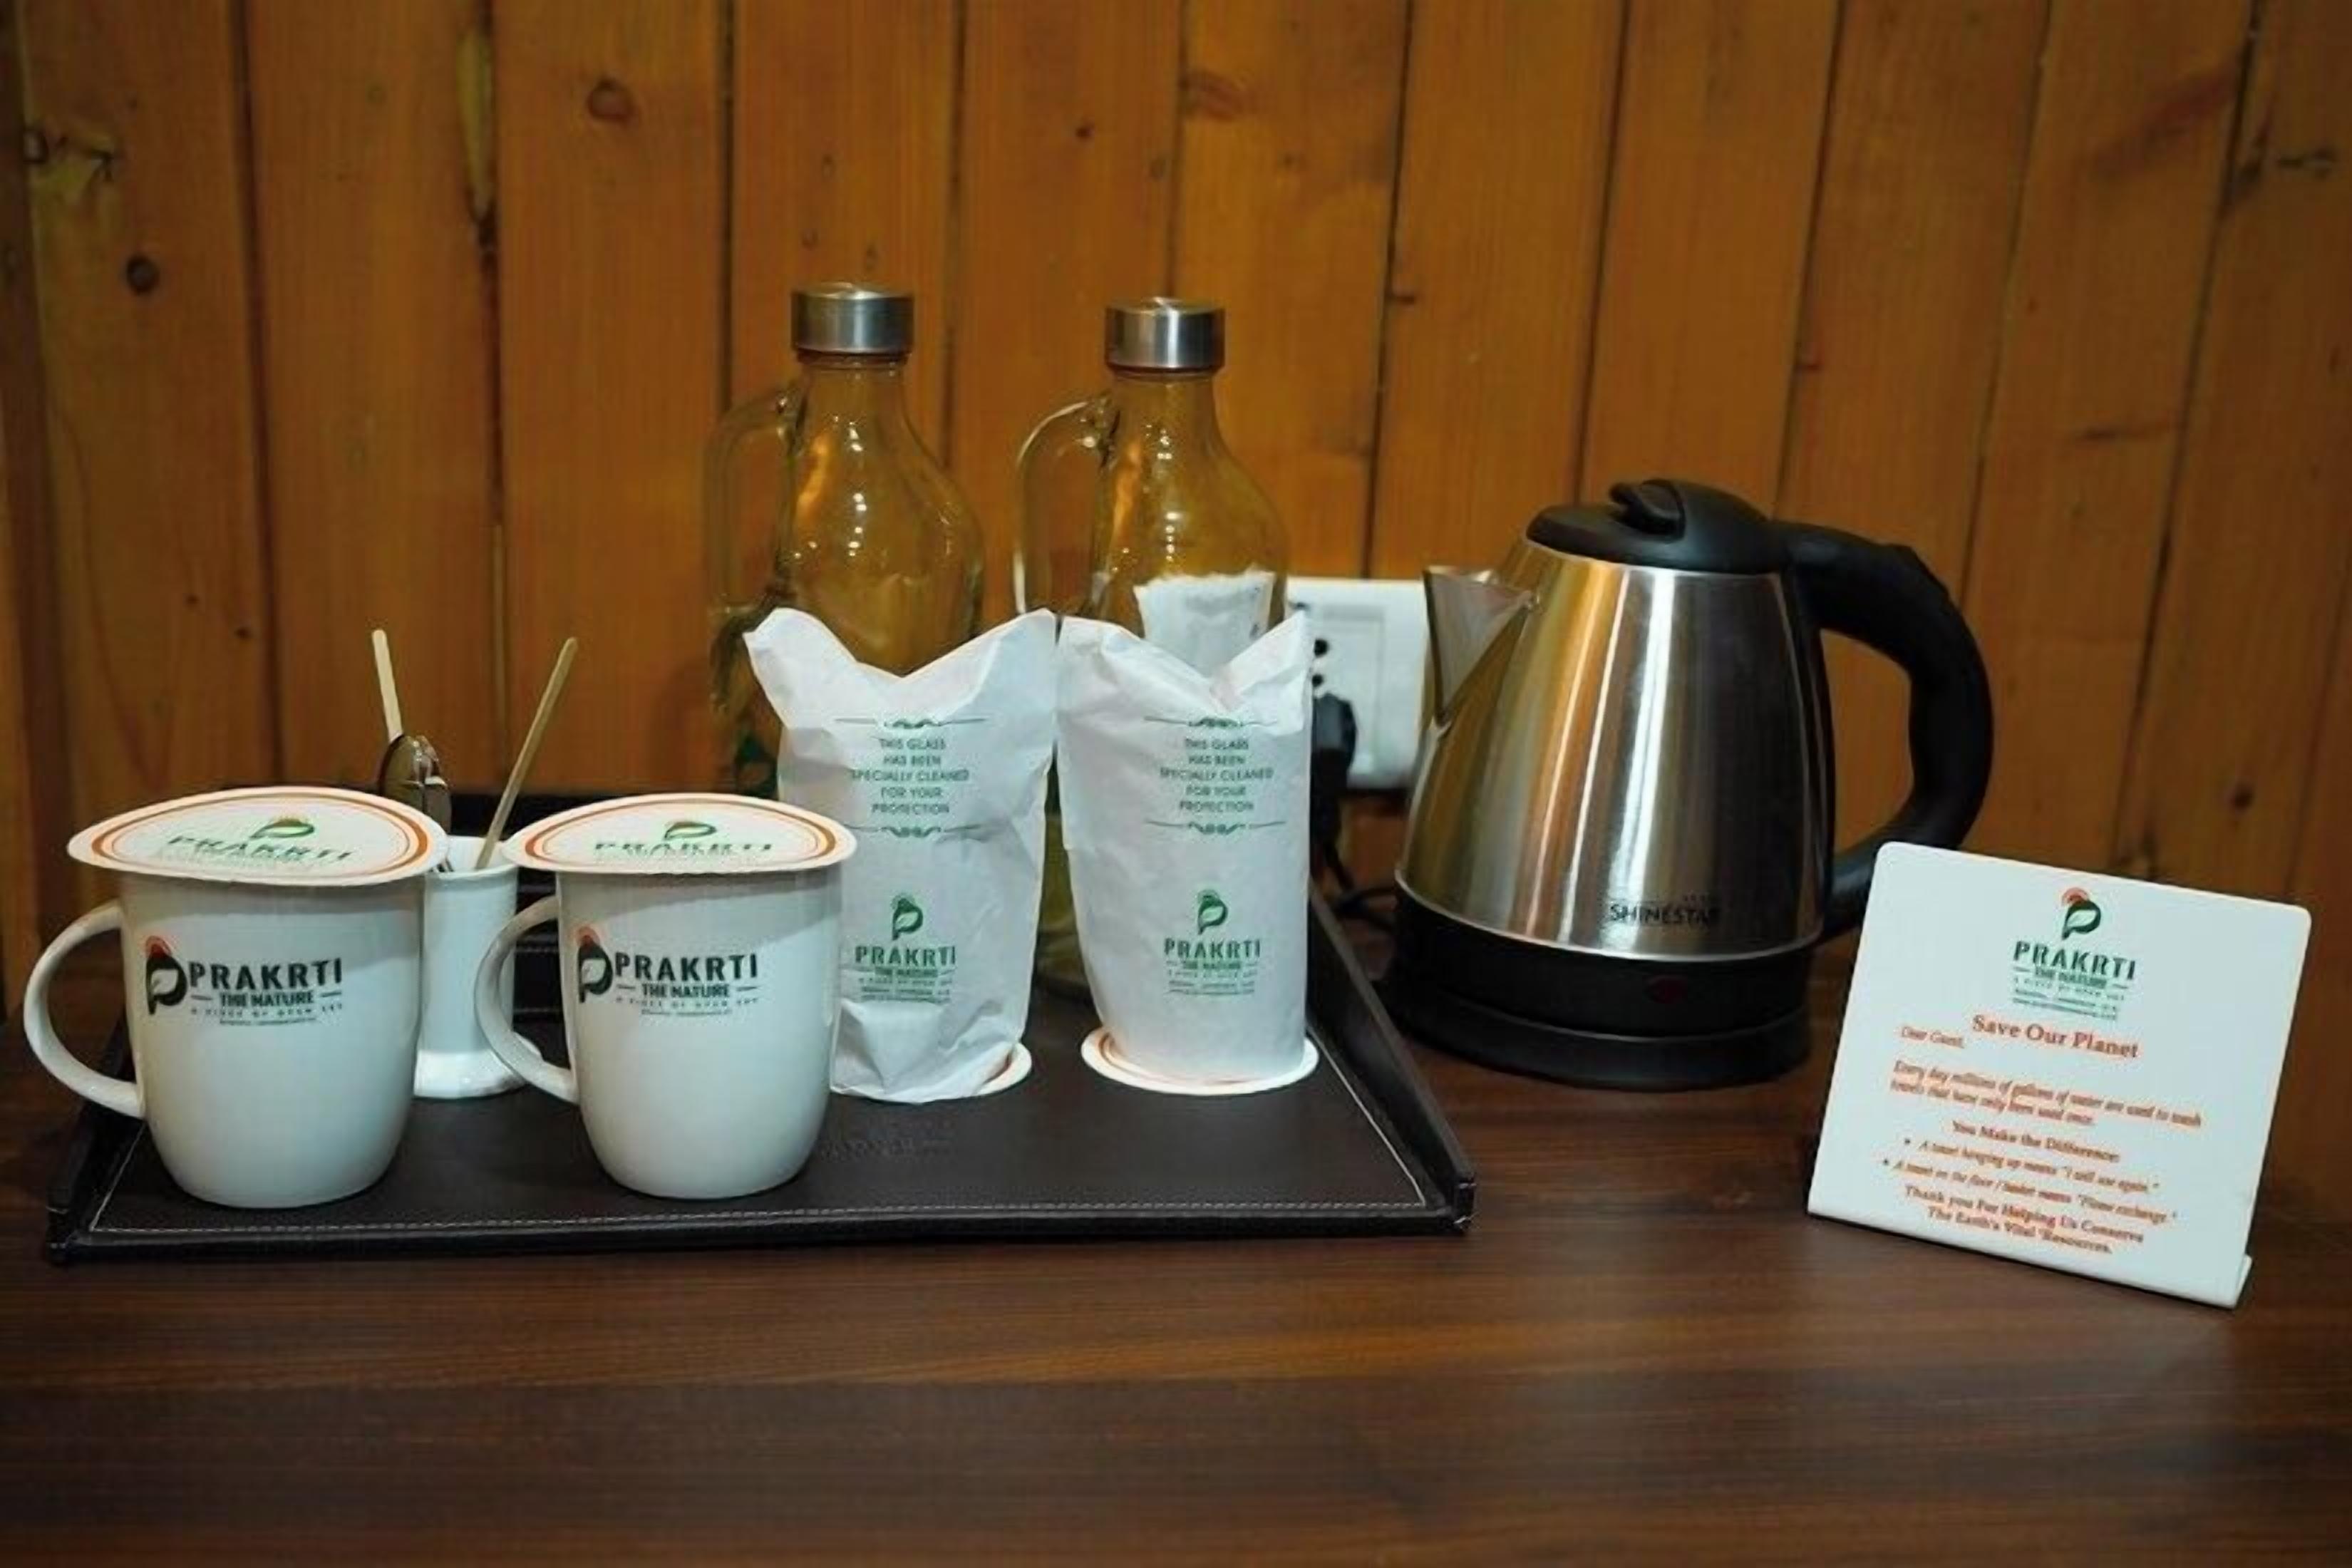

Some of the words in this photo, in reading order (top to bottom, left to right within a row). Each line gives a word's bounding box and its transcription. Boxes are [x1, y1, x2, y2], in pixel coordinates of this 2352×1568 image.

[856, 946, 955, 966] PRAKRTI
[1164, 938, 1260, 958] PRAKRTI
[2013, 941, 2136, 980] PRAKRTI
[189, 957, 342, 990] PRAKRTI
[615, 951, 758, 981] PRAKRTI
[220, 991, 248, 1007] THE
[251, 989, 314, 1007] NATURE
[642, 984, 667, 997] THE
[671, 984, 730, 999] NATURE
[1973, 1015, 2021, 1038] Save
[2026, 1023, 2067, 1045] Our
[2073, 1031, 2138, 1058] Planet
[1952, 1120, 1976, 1136] You
[1979, 1125, 2017, 1143] Make
[2021, 1133, 2042, 1147] the
[1904, 1184, 1945, 1203] Thank
[1948, 1197, 1974, 1210] you
[1928, 1205, 1953, 1220] The
